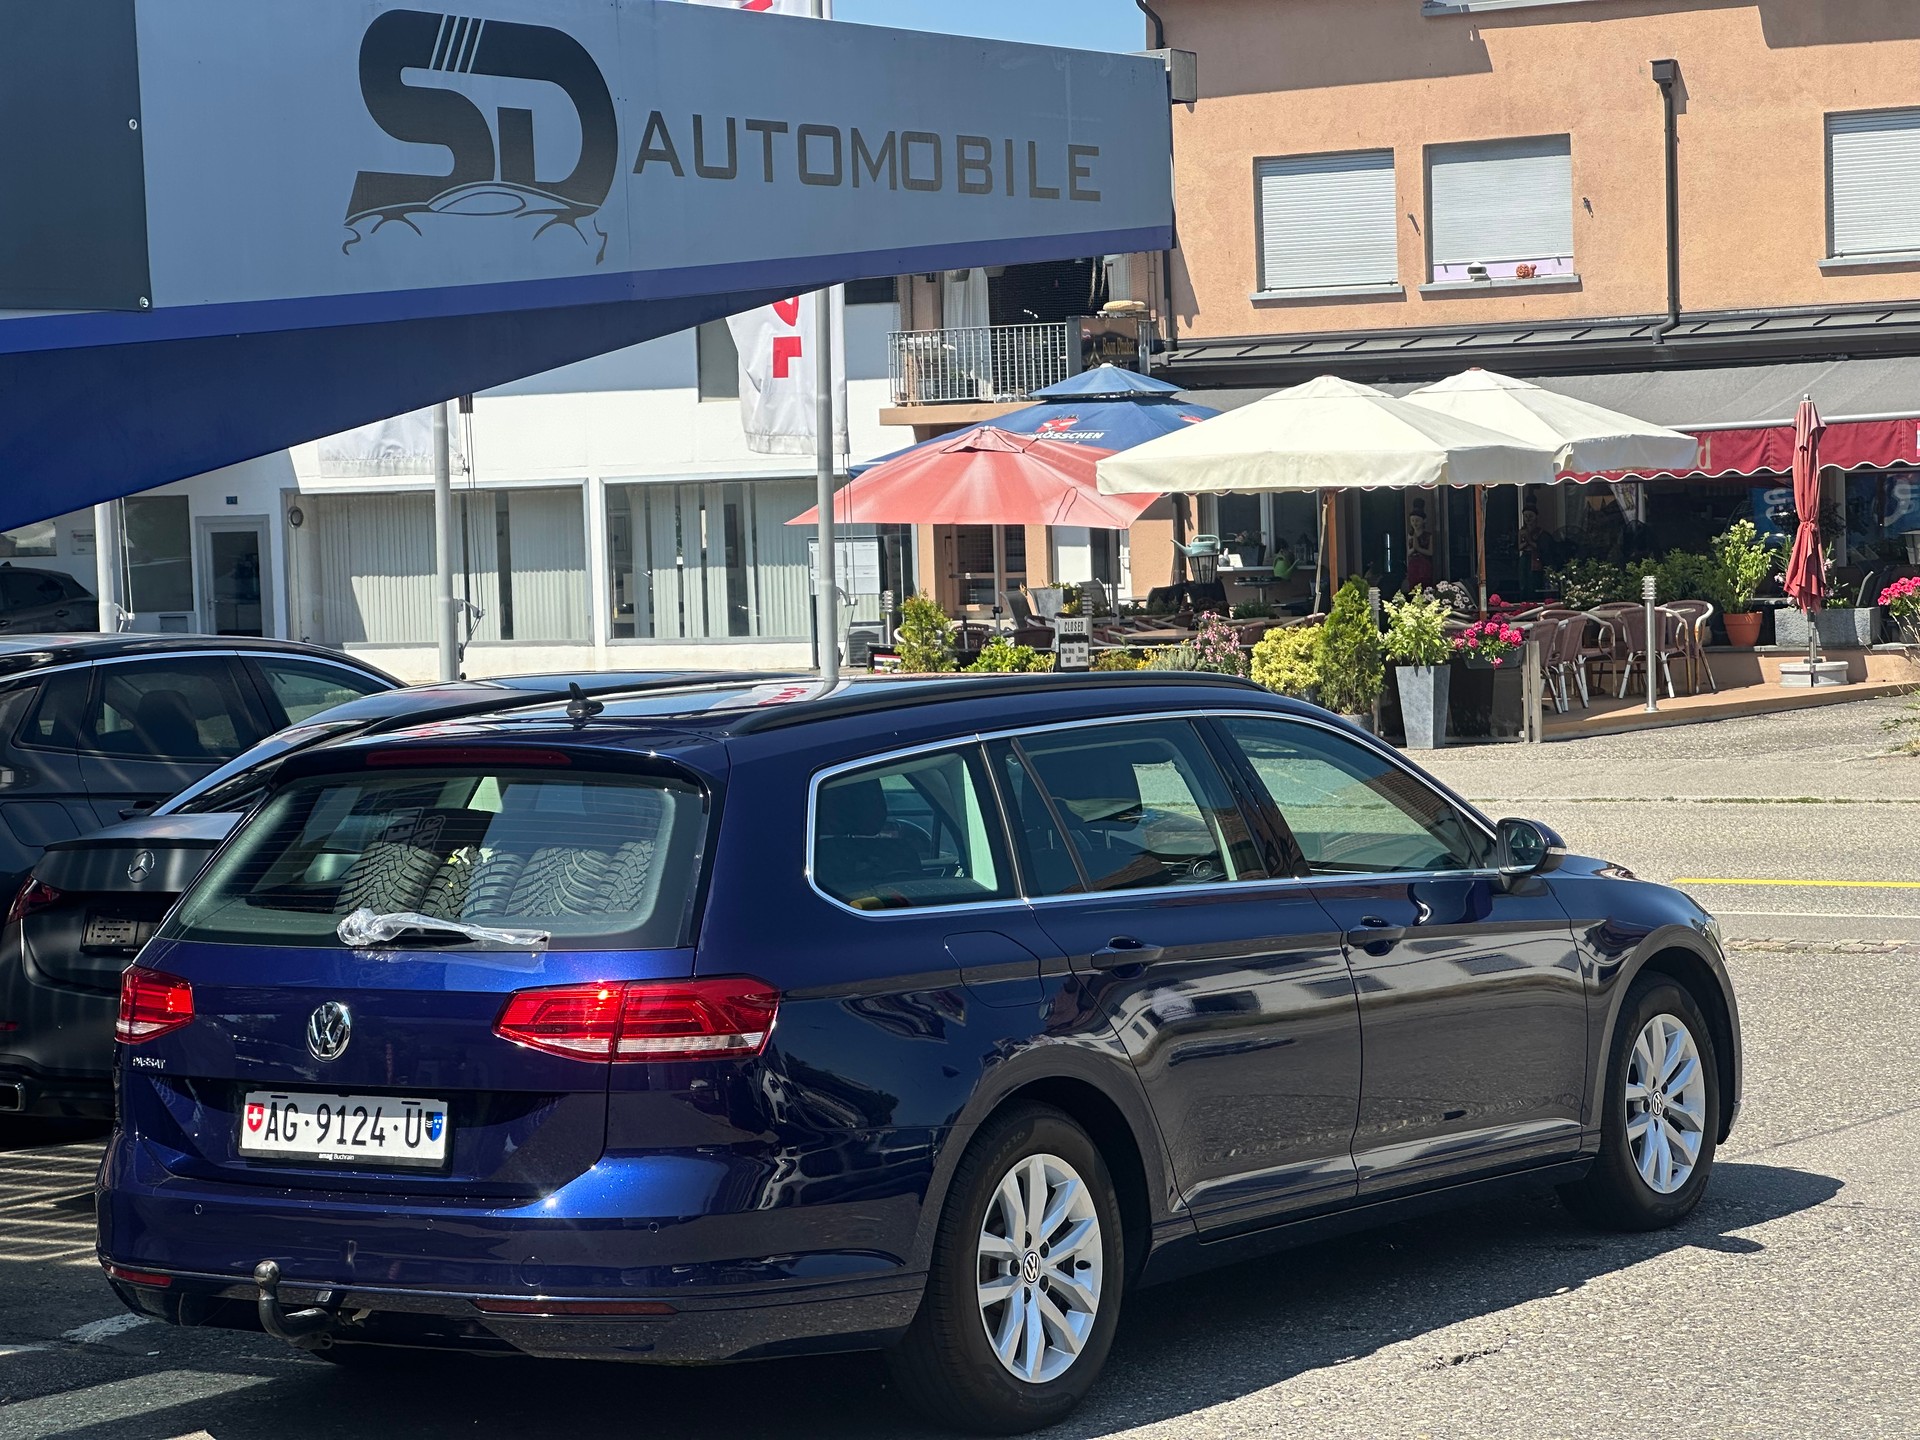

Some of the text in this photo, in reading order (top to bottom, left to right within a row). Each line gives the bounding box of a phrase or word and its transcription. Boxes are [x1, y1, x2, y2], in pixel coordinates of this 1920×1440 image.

[345, 8, 1101, 222] SD AUTOMOBILE
[1064, 621, 1084, 632] CLOSED
